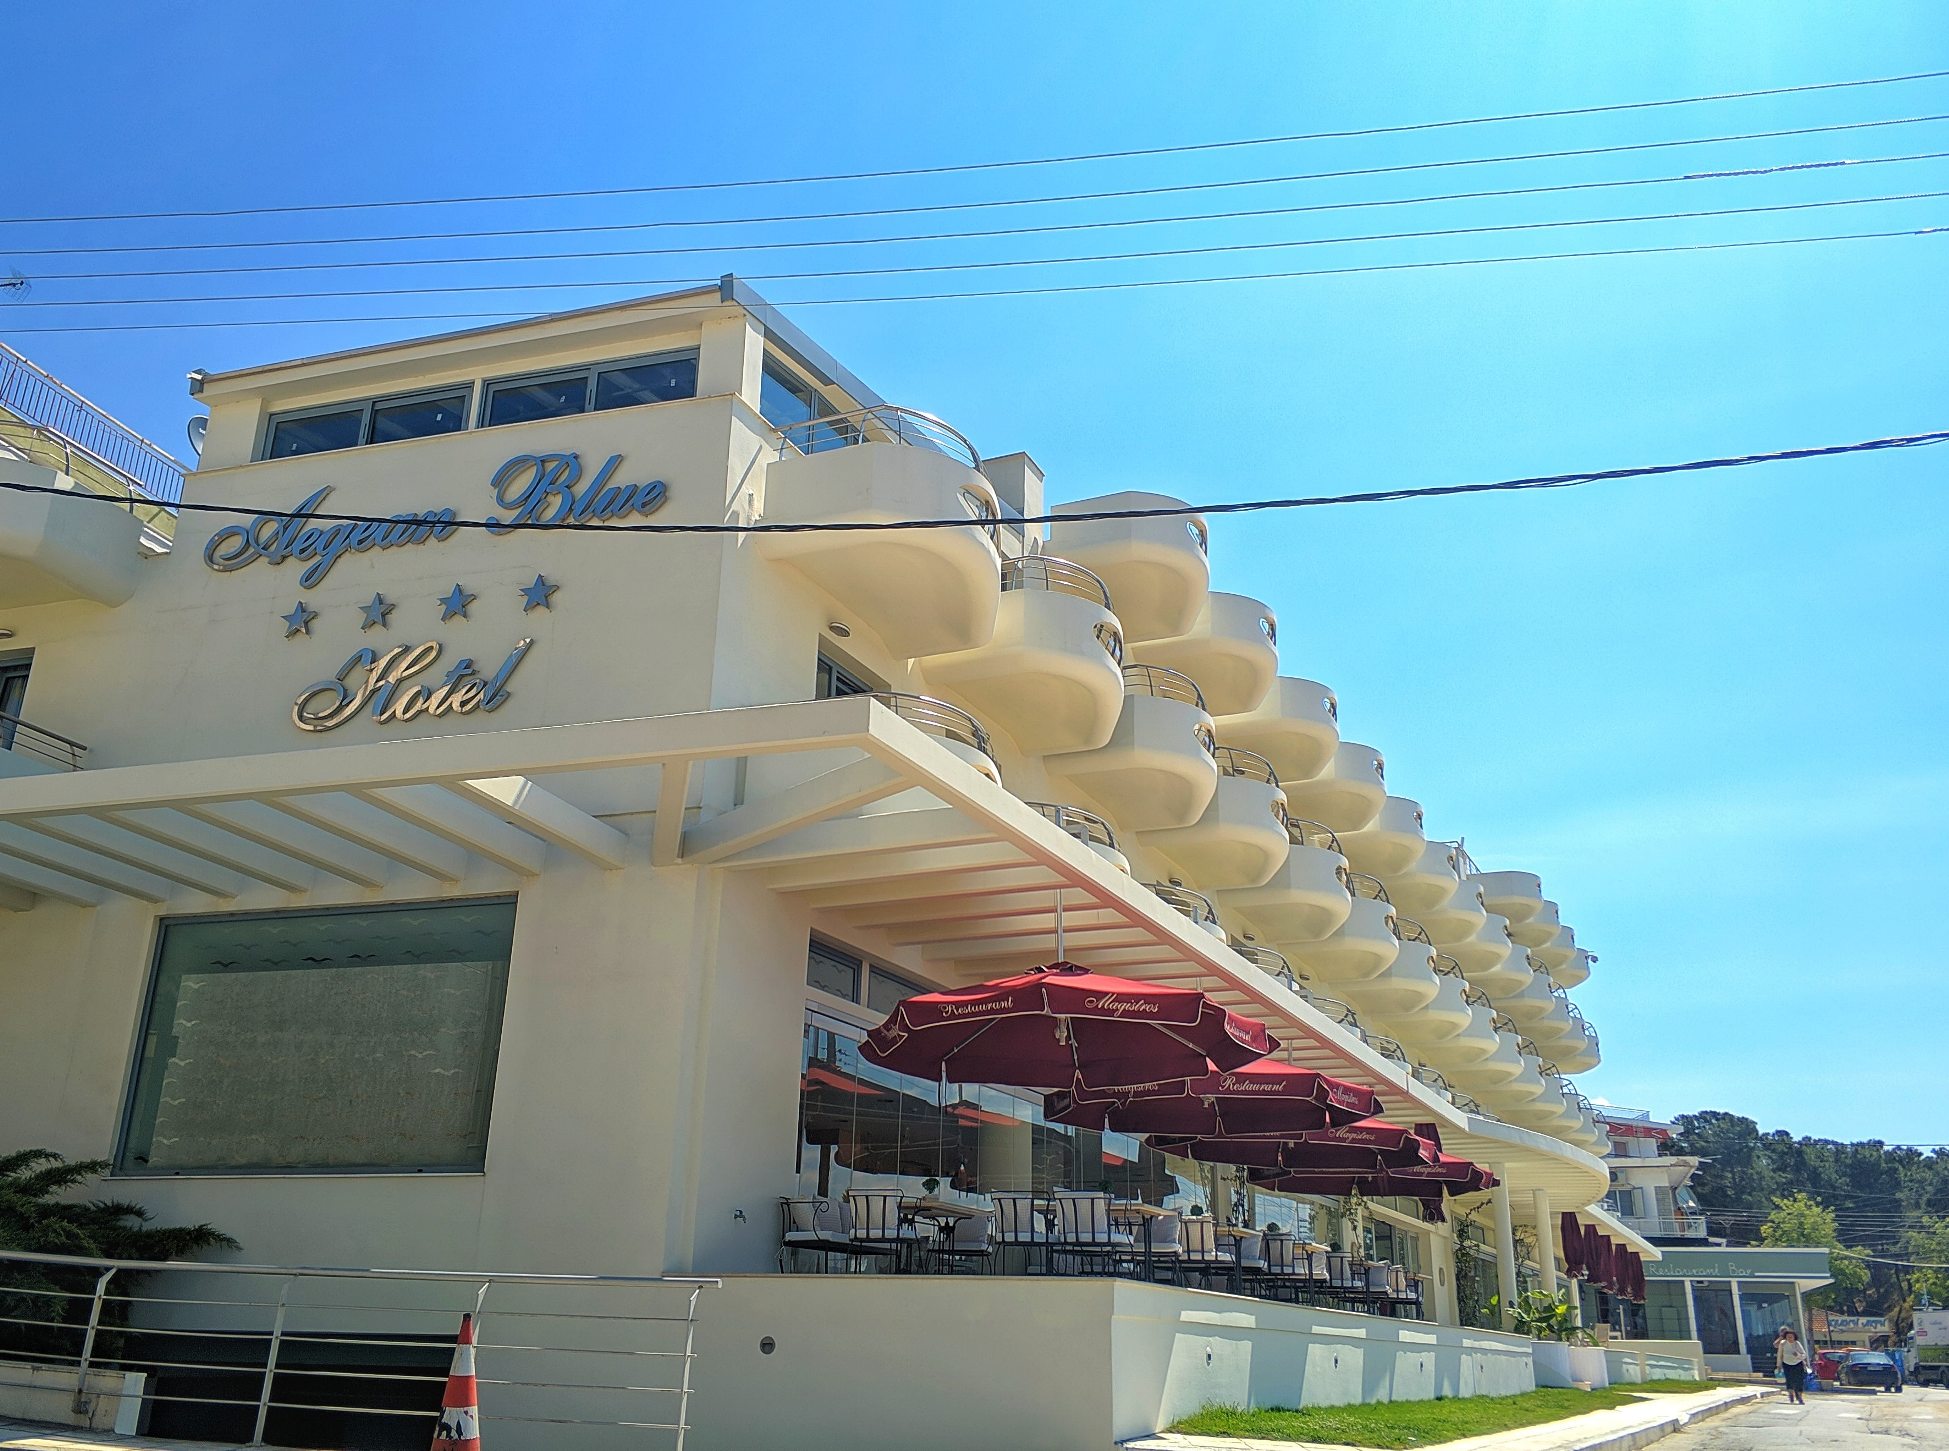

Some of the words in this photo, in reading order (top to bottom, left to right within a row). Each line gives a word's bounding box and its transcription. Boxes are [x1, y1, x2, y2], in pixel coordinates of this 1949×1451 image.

[203, 484, 458, 590] Aegean
[484, 452, 670, 536] Blue
[291, 637, 535, 733] Hotel
[938, 996, 1014, 1017] Restaurant
[1084, 993, 1159, 1017] Magistros
[1218, 1075, 1287, 1092] Restaurant
[1327, 1126, 1376, 1143] Magistros
[1648, 1263, 1720, 1276] Restaurant
[1728, 1262, 1752, 1276] Bar
